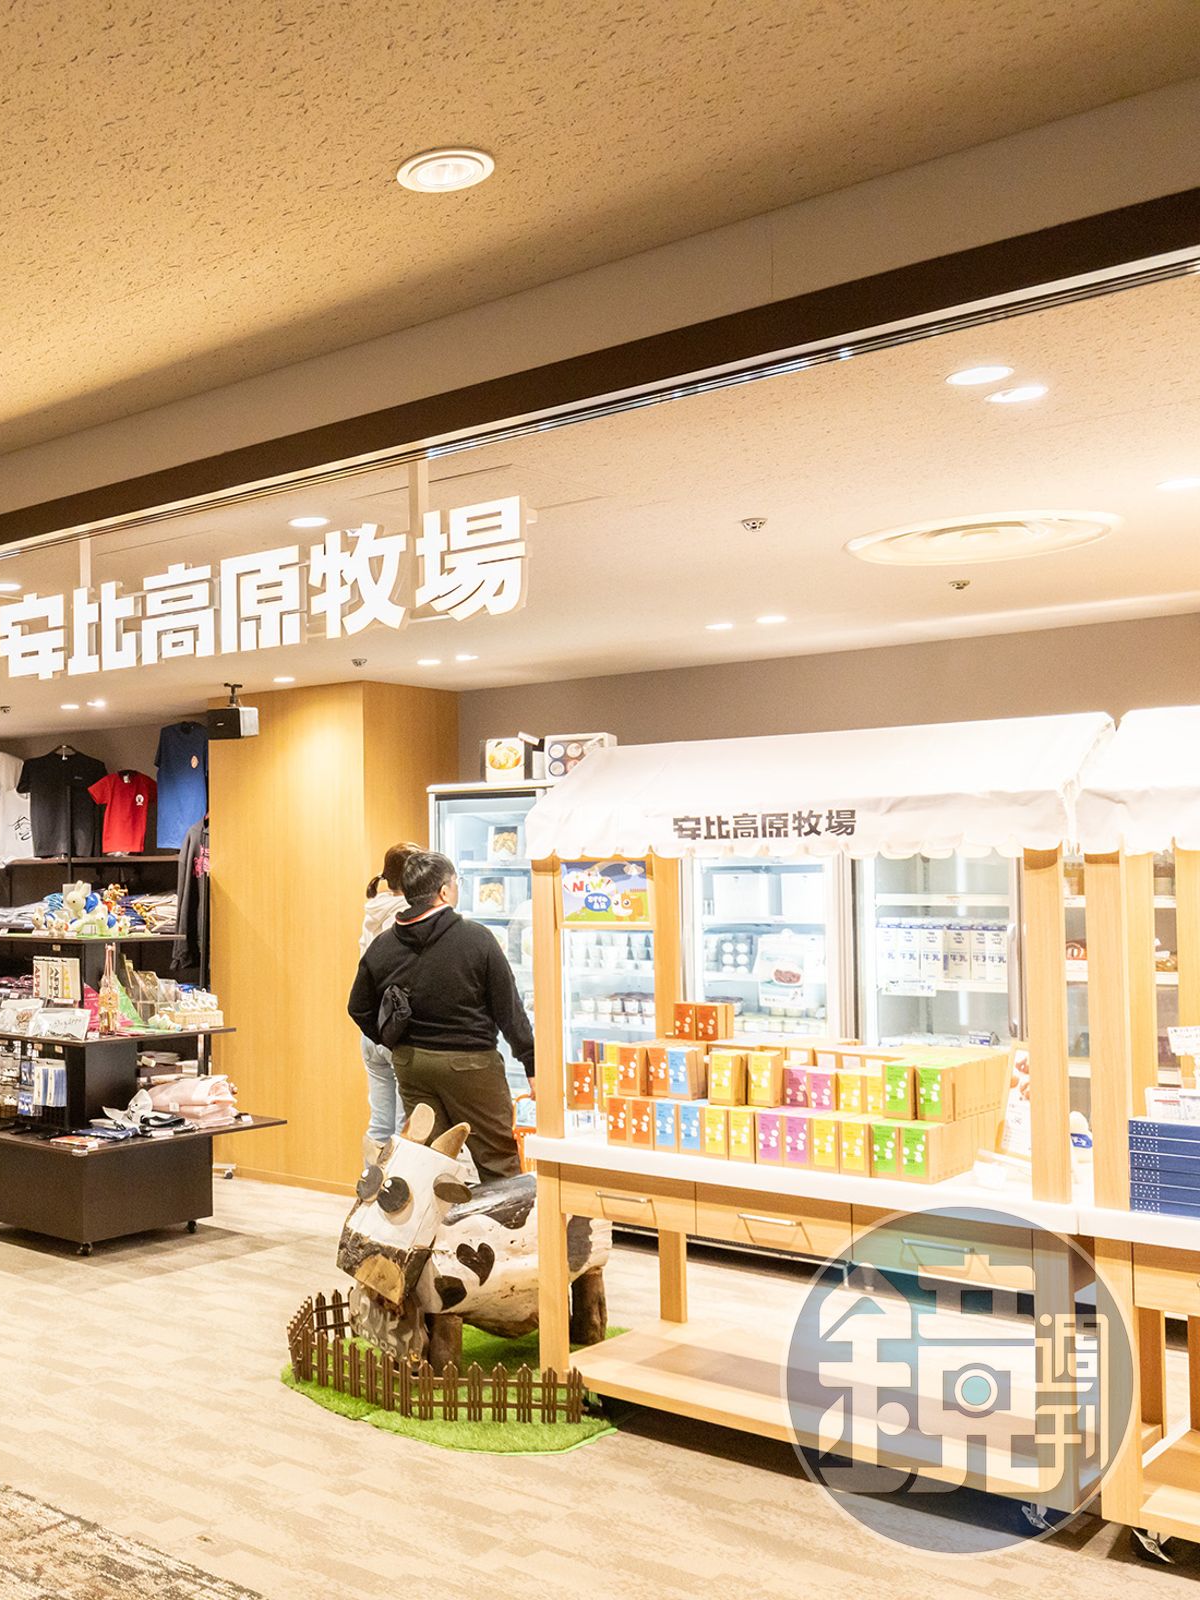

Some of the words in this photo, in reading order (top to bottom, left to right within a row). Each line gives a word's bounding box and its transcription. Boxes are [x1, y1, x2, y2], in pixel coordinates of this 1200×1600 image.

[673, 809, 856, 840] 安比高原牧場
